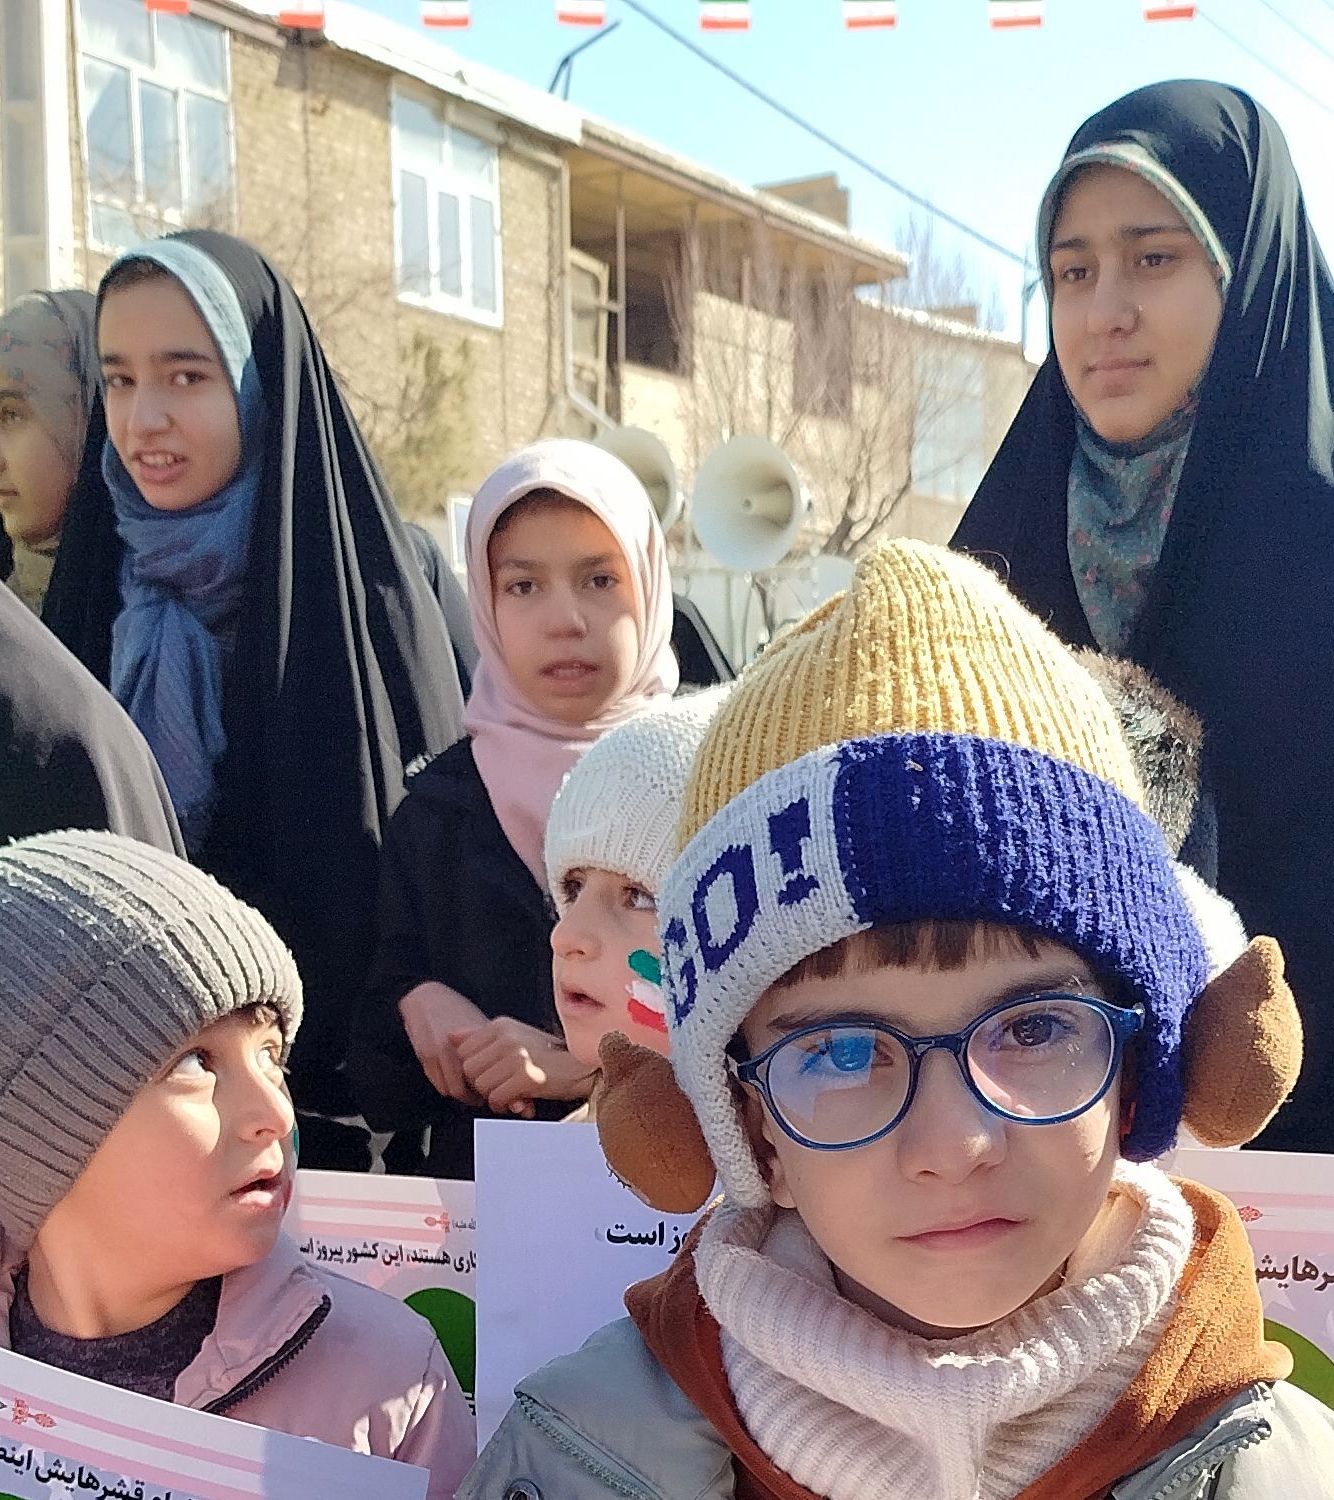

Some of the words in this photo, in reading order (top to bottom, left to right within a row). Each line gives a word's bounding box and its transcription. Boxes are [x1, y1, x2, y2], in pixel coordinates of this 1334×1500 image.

[606, 1221, 665, 1246] است
[299, 1237, 315, 1255] اس
[316, 1240, 343, 1265] پیروز
[346, 1241, 380, 1264] کشور
[382, 1244, 404, 1267] این
